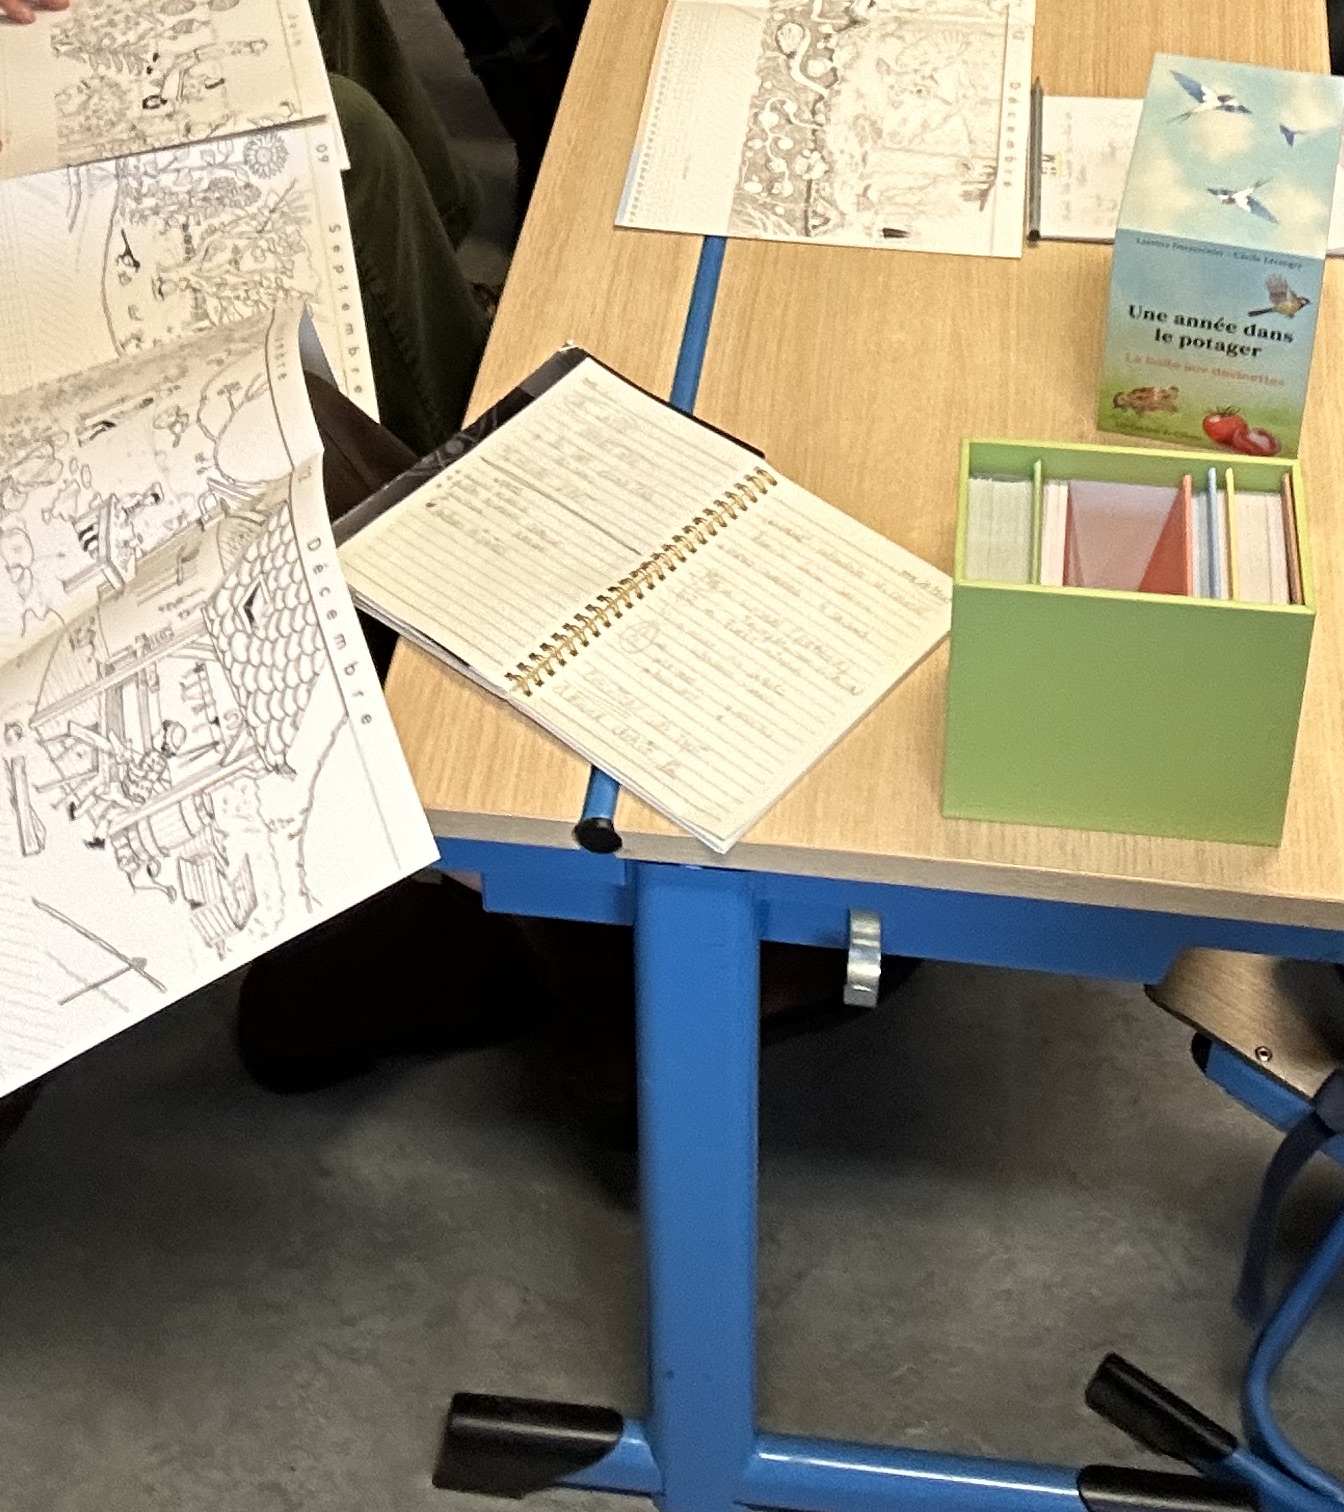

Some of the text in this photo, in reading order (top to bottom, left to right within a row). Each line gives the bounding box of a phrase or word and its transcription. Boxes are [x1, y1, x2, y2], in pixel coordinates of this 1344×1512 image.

[315, 143, 364, 395] 09 Septembre
[1128, 303, 1295, 344] Une année dans
[1154, 328, 1263, 359] le potager
[305, 537, 374, 727] Décembre
